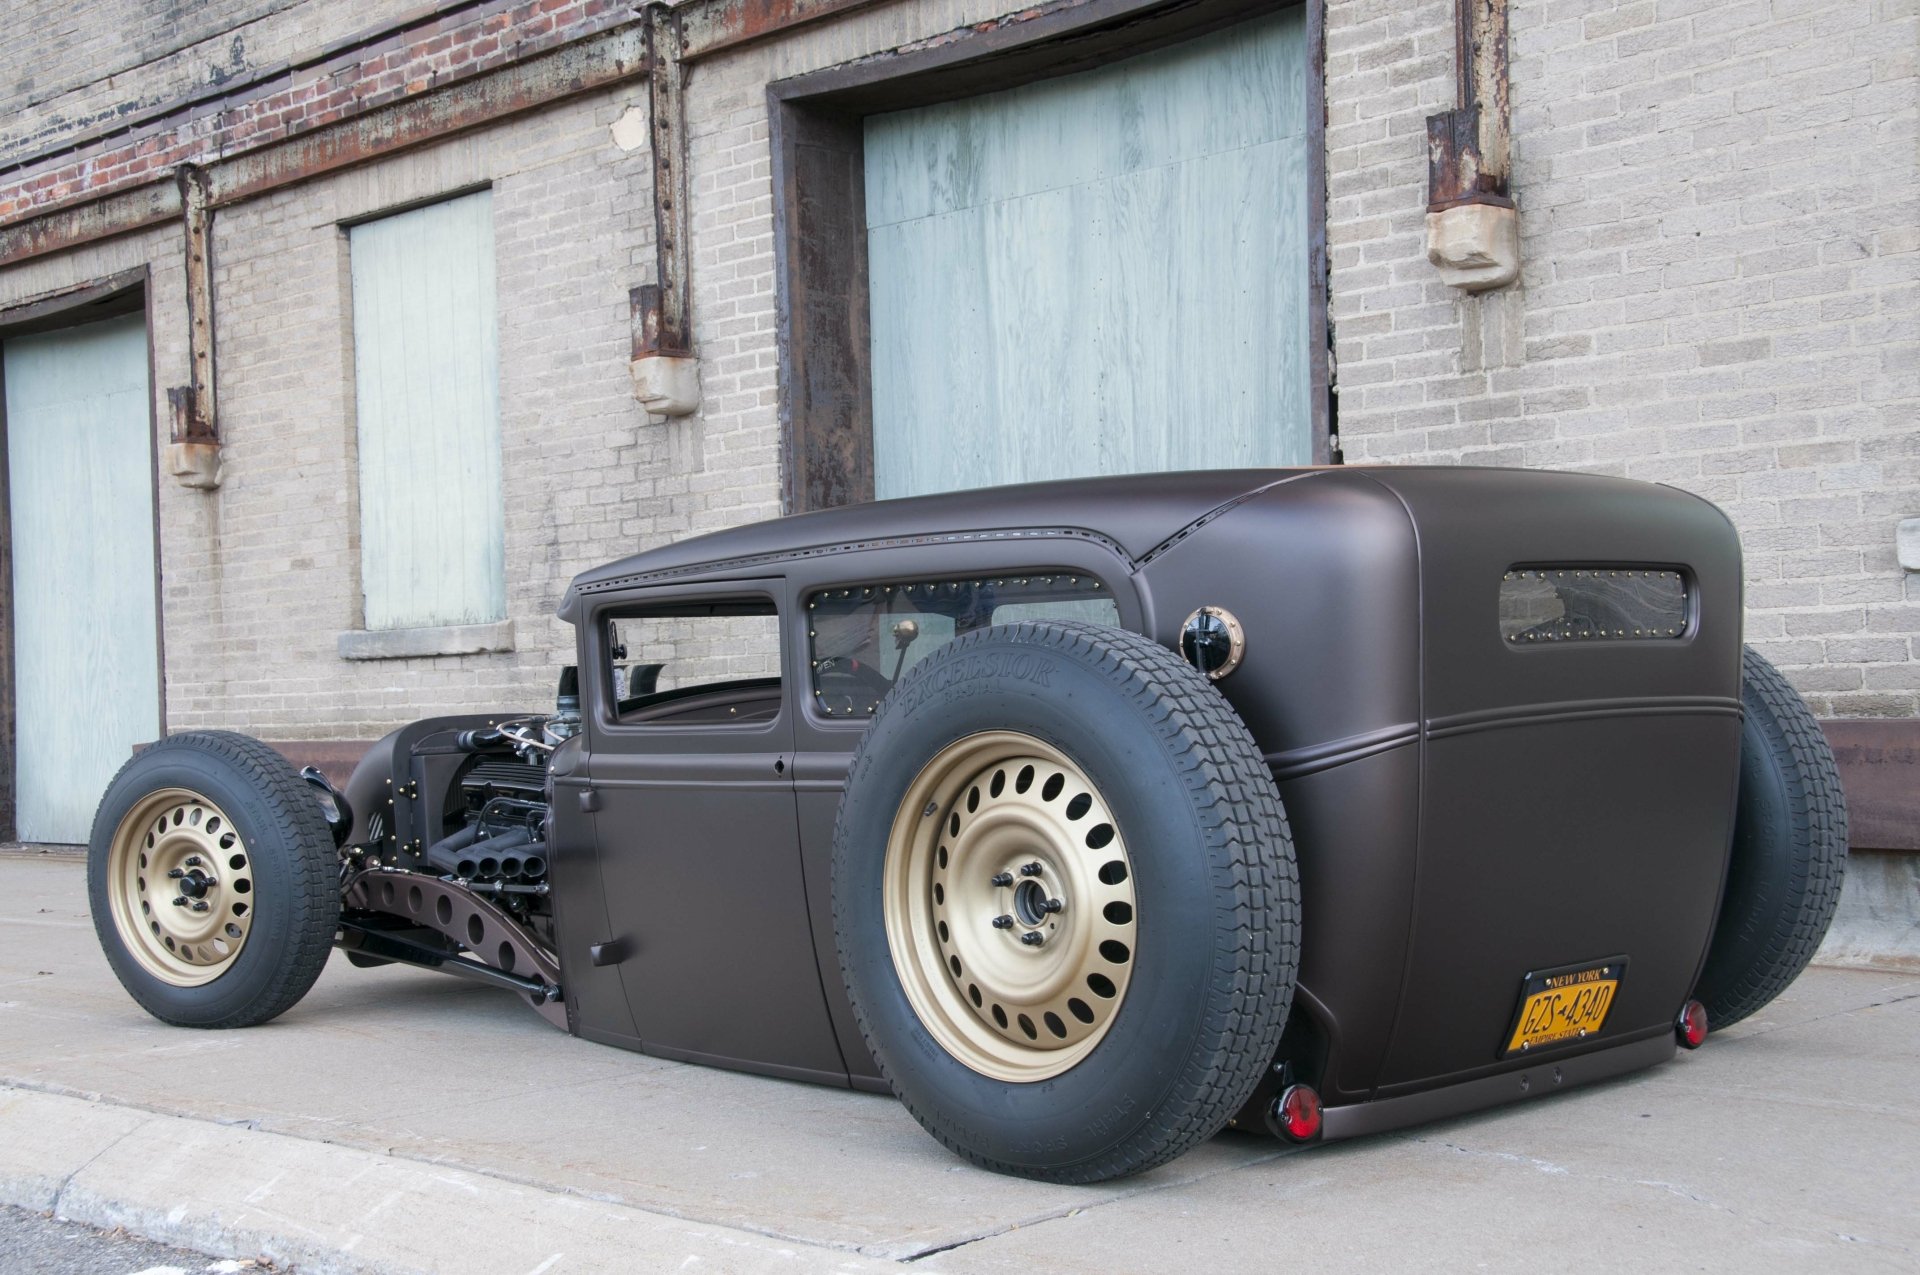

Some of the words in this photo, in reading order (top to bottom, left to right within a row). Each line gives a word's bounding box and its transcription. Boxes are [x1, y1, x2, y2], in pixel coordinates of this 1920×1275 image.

[902, 652, 1056, 718] EXCELSIOR
[1551, 973, 1575, 988] NEW
[1577, 968, 1601, 983] YORK
[1523, 994, 1562, 1035] GZS
[1565, 985, 1610, 1026] 4340
